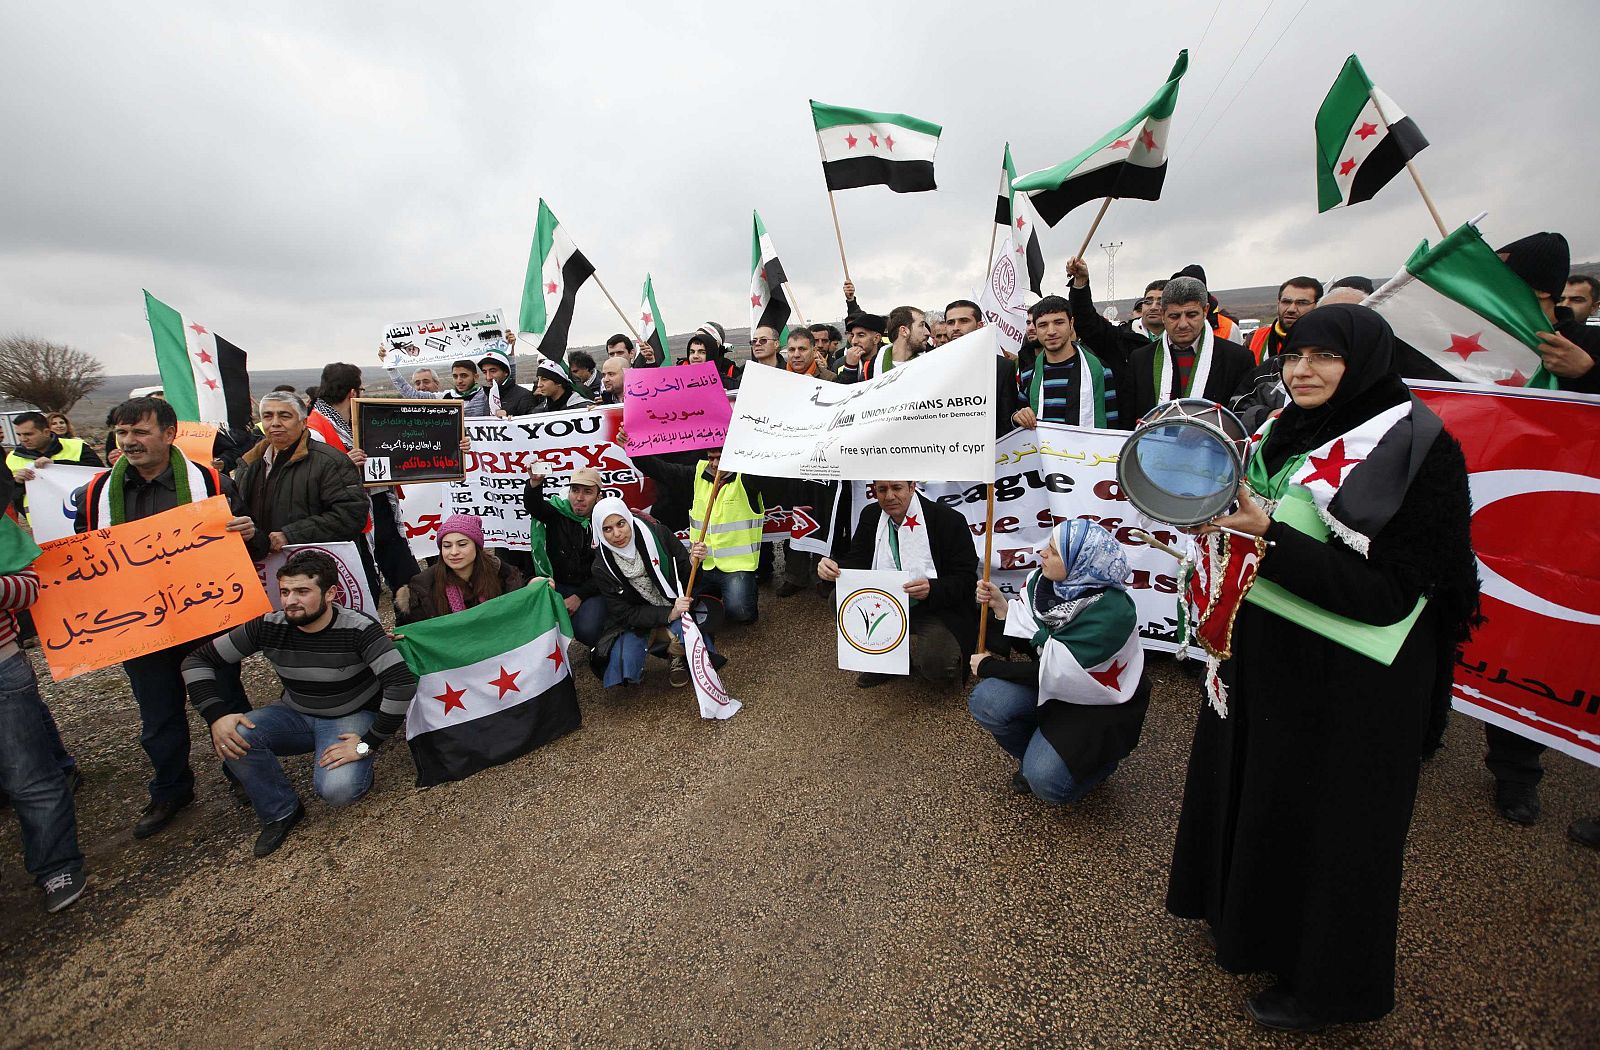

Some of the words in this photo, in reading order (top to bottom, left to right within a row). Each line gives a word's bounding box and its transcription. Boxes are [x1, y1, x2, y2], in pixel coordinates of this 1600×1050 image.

[449, 320, 470, 332] يريد
[471, 313, 501, 329] الشعب
[386, 326, 414, 342] النظام
[686, 373, 718, 388] قافلة
[646, 408, 705, 424] سورية
[861, 407, 887, 420] UNION
[898, 398, 944, 413] SYRIANS
[903, 413, 938, 421] Revolution
[464, 425, 513, 443] ANK
[518, 415, 603, 440] YOU
[402, 442, 415, 452] ثورة
[840, 445, 858, 455] Free
[860, 445, 886, 456] syrian
[890, 443, 946, 456] community
[949, 442, 960, 453] of
[464, 443, 612, 474] URKEY
[936, 469, 1076, 508] eagle
[451, 491, 473, 504] HE
